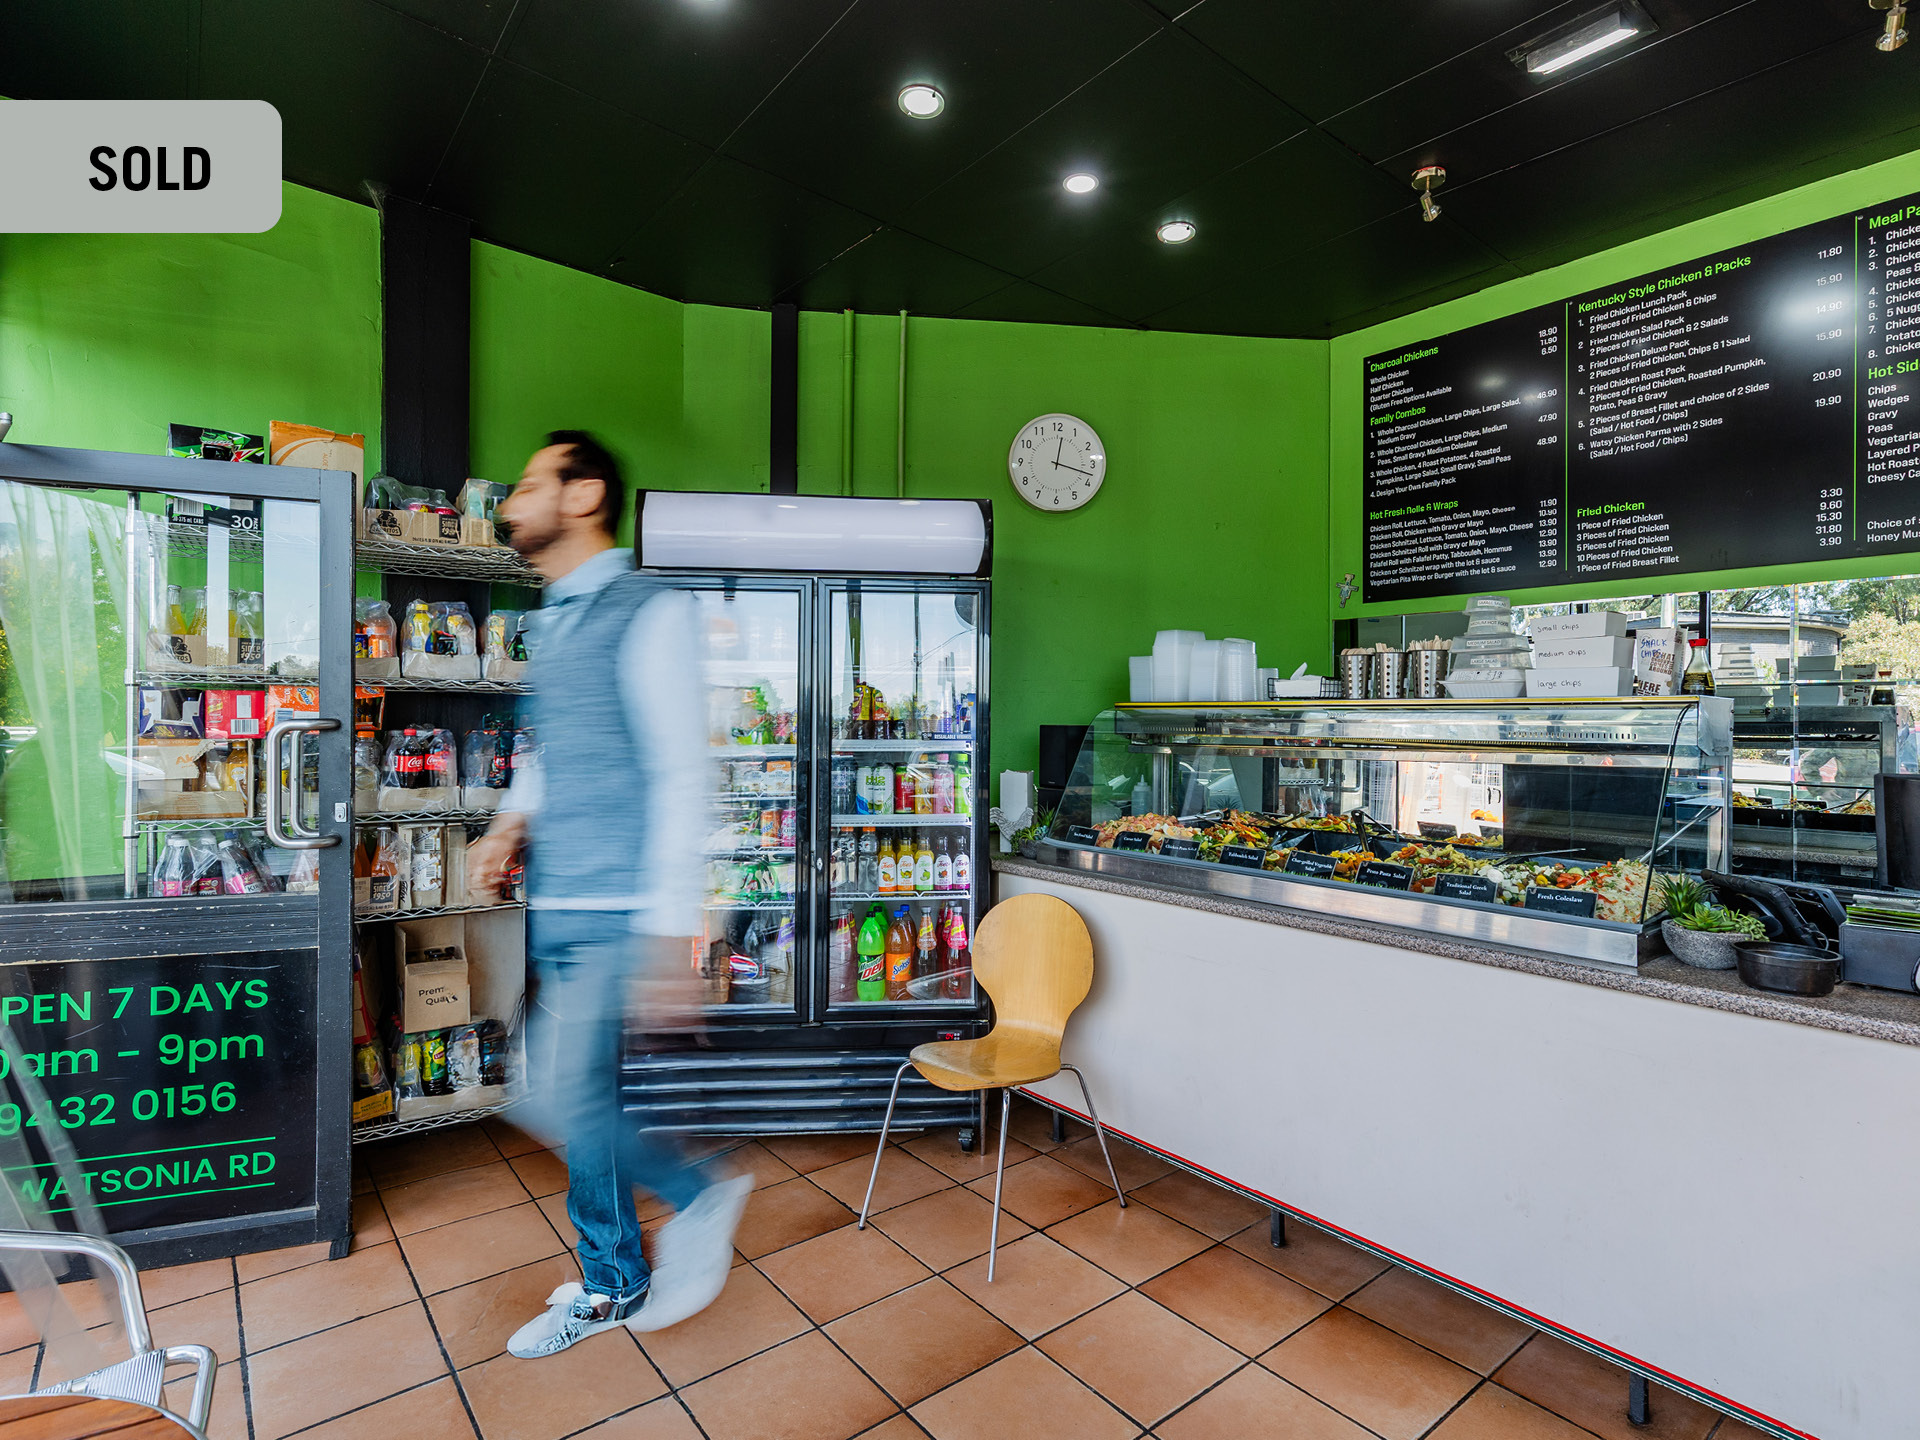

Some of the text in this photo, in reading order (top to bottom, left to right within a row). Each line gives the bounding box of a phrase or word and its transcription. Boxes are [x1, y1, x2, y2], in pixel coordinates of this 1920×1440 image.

[1870, 210, 1903, 229] Meal
[1818, 246, 1842, 259] 11.80
[1886, 267, 1912, 279] Peas
[1578, 256, 1751, 313] Kentucky Style Chicken & Packs
[1816, 273, 1842, 286] 15.90
[1589, 311, 1608, 323] Fried
[1609, 303, 1640, 318] Chicken
[1640, 295, 1666, 309] Lunch
[1666, 290, 1687, 302] Pack
[1816, 302, 1841, 313] 14.90
[1589, 293, 1717, 333] 2 Pieces of Fried Chicken & Chips
[1816, 329, 1841, 341] 15.90
[1370, 346, 1438, 372] Charcoal Chickens
[1813, 369, 1841, 380] 20.90
[1869, 359, 1920, 379] Hot Sid
[1370, 369, 1409, 384] Whole Chicken
[1370, 387, 1413, 402] Quarter Chicken
[1868, 383, 1896, 395] Chips
[1589, 390, 1667, 413] Potato, Peas & Gravy
[1815, 395, 1841, 407] 19.90
[1868, 394, 1909, 408] Wedges
[1369, 405, 1426, 426] Family Combos
[1868, 410, 1898, 421] Gravy
[1034, 427, 1044, 435] 11
[1053, 422, 1063, 432] 12
[1589, 438, 1613, 448] Watsy
[1613, 432, 1644, 444] Chicken
[1645, 427, 1671, 438] Parma
[1672, 422, 1691, 432] with
[1699, 417, 1723, 428] Sides
[1868, 423, 1893, 433] Peas
[1021, 440, 1032, 449] 10
[1085, 442, 1091, 451] 2
[1589, 447, 1613, 459] (Salad
[1620, 443, 1634, 453] Hot
[1635, 439, 1654, 450] Food
[1661, 433, 1688, 445] Chips)
[1868, 445, 1910, 459] Layered
[1018, 458, 1024, 467] 9
[1090, 460, 1096, 469] 3
[1868, 456, 1920, 472] Hot Roast
[1022, 476, 1028, 485] 8
[1085, 478, 1091, 487] 4
[1868, 472, 1905, 483] Cheesy
[1036, 490, 1041, 499] 7
[1072, 491, 1078, 500] 5
[1820, 488, 1842, 498] 3.30
[1054, 496, 1059, 505] 6
[1820, 500, 1842, 510] 9.60
[1576, 501, 1645, 517] Fried Chicken
[231, 514, 252, 530] 30
[1816, 512, 1842, 522] 15.30
[1868, 516, 1916, 529] Choice of
[1816, 524, 1841, 535] 31.80
[1820, 537, 1841, 546] 3.90
[1868, 530, 1920, 543] Honey Mu
[1576, 545, 1673, 562] 10 Pieces of Fried Chicken
[1576, 555, 1679, 572] 1 Piece of Fried Breast Fillet
[1538, 680, 1557, 689] large
[1393, 871, 1406, 880] Salad
[1473, 884, 1488, 892] Greek
[1537, 892, 1584, 903] Fresh Coleslaw
[109, 987, 134, 1019] 7
[150, 979, 269, 1017] DAYS
[158, 1033, 264, 1073] 9pm
[132, 1081, 236, 1121] 0156
[229, 1151, 276, 1178] RD
